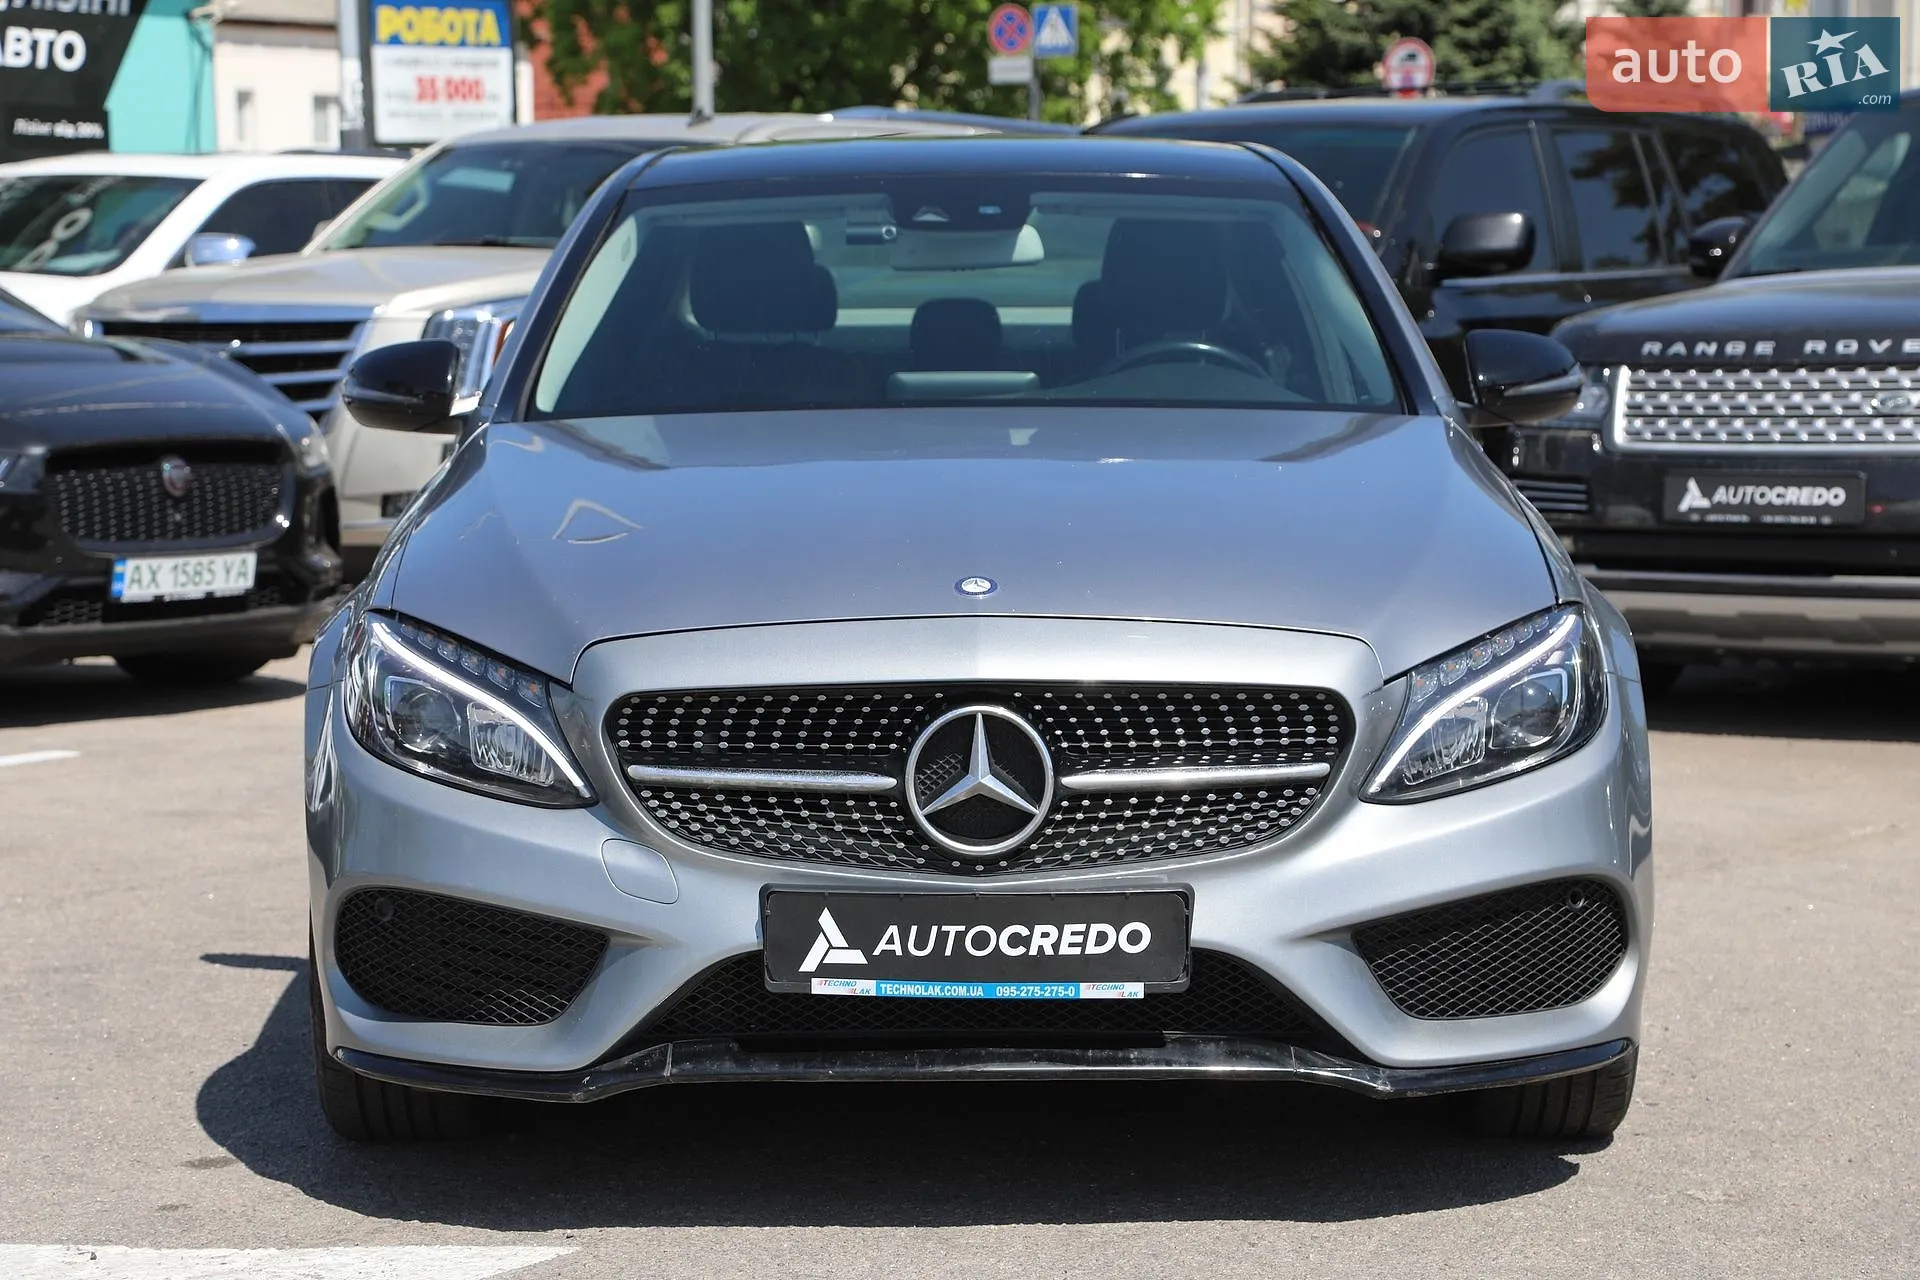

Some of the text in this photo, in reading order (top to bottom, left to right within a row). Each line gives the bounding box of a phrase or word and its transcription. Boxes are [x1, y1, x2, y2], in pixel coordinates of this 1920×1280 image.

[375, 5, 501, 45] РОБОТА
[0, 26, 87, 72] ВТО
[1641, 340, 1776, 357] RANGE
[1711, 485, 1847, 507] AUTOCREDO
[128, 564, 163, 591] AX
[169, 560, 217, 588] 1585
[872, 920, 1152, 958] AUTOCREDO
[822, 979, 1125, 998] TECHNO TECHNOLAK.COM.UA 095-275-275-0 TECHNO
[852, 987, 872, 996] LAK
[1120, 990, 1139, 998] LAK
